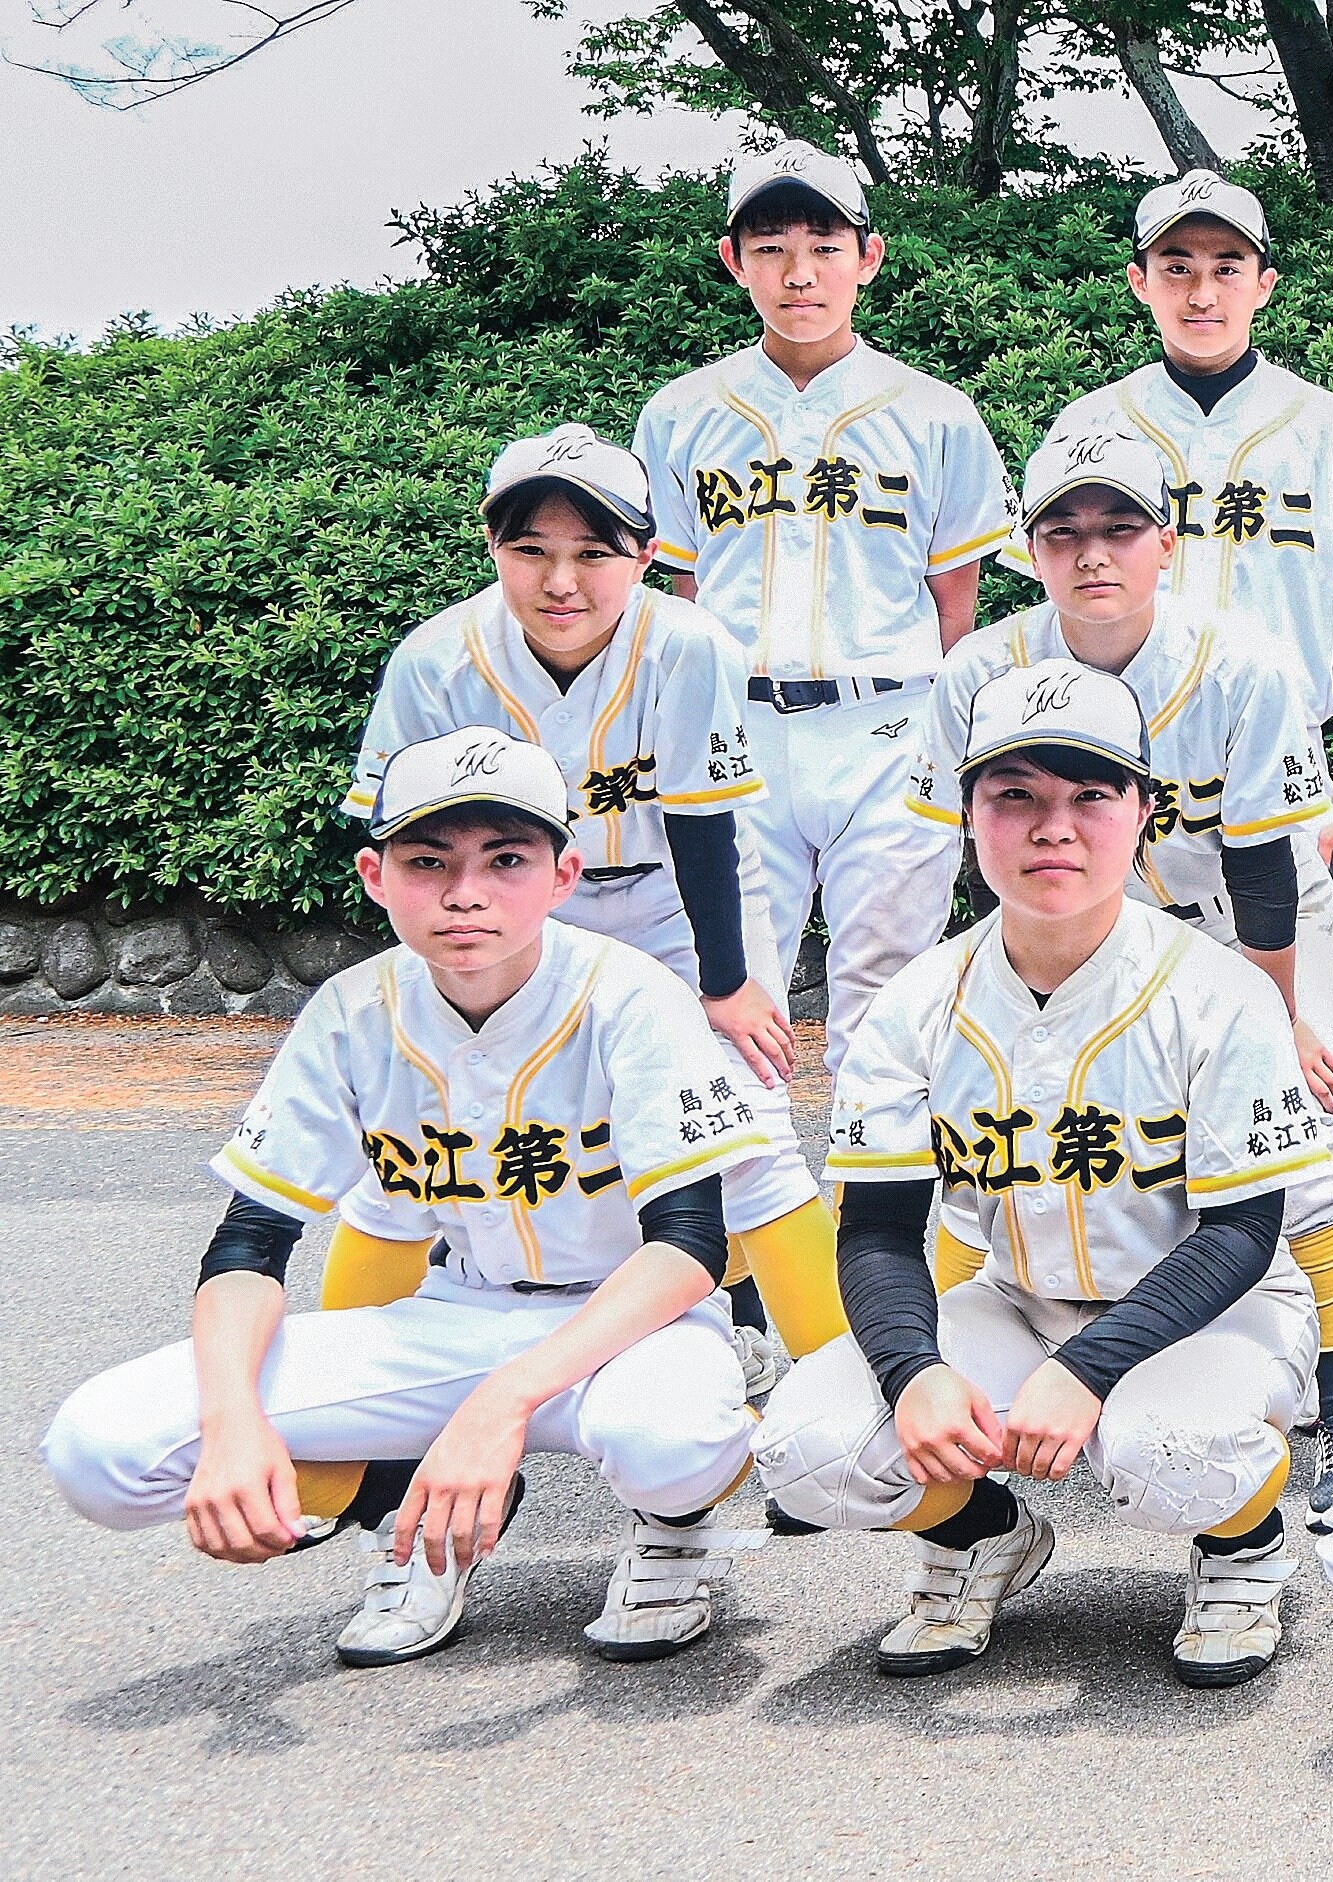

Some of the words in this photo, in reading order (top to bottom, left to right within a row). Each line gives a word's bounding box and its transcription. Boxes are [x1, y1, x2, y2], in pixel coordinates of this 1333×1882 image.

[695, 458, 909, 533] 松江第二
[1168, 480, 1316, 551] 江第二
[680, 1076, 736, 1114] 島根
[680, 1101, 754, 1144] 松江市
[1253, 1086, 1305, 1125] 島根
[368, 1121, 624, 1206] 松江第二
[931, 1104, 1187, 1193] 松江第二
[1247, 1116, 1317, 1157] 松江市
